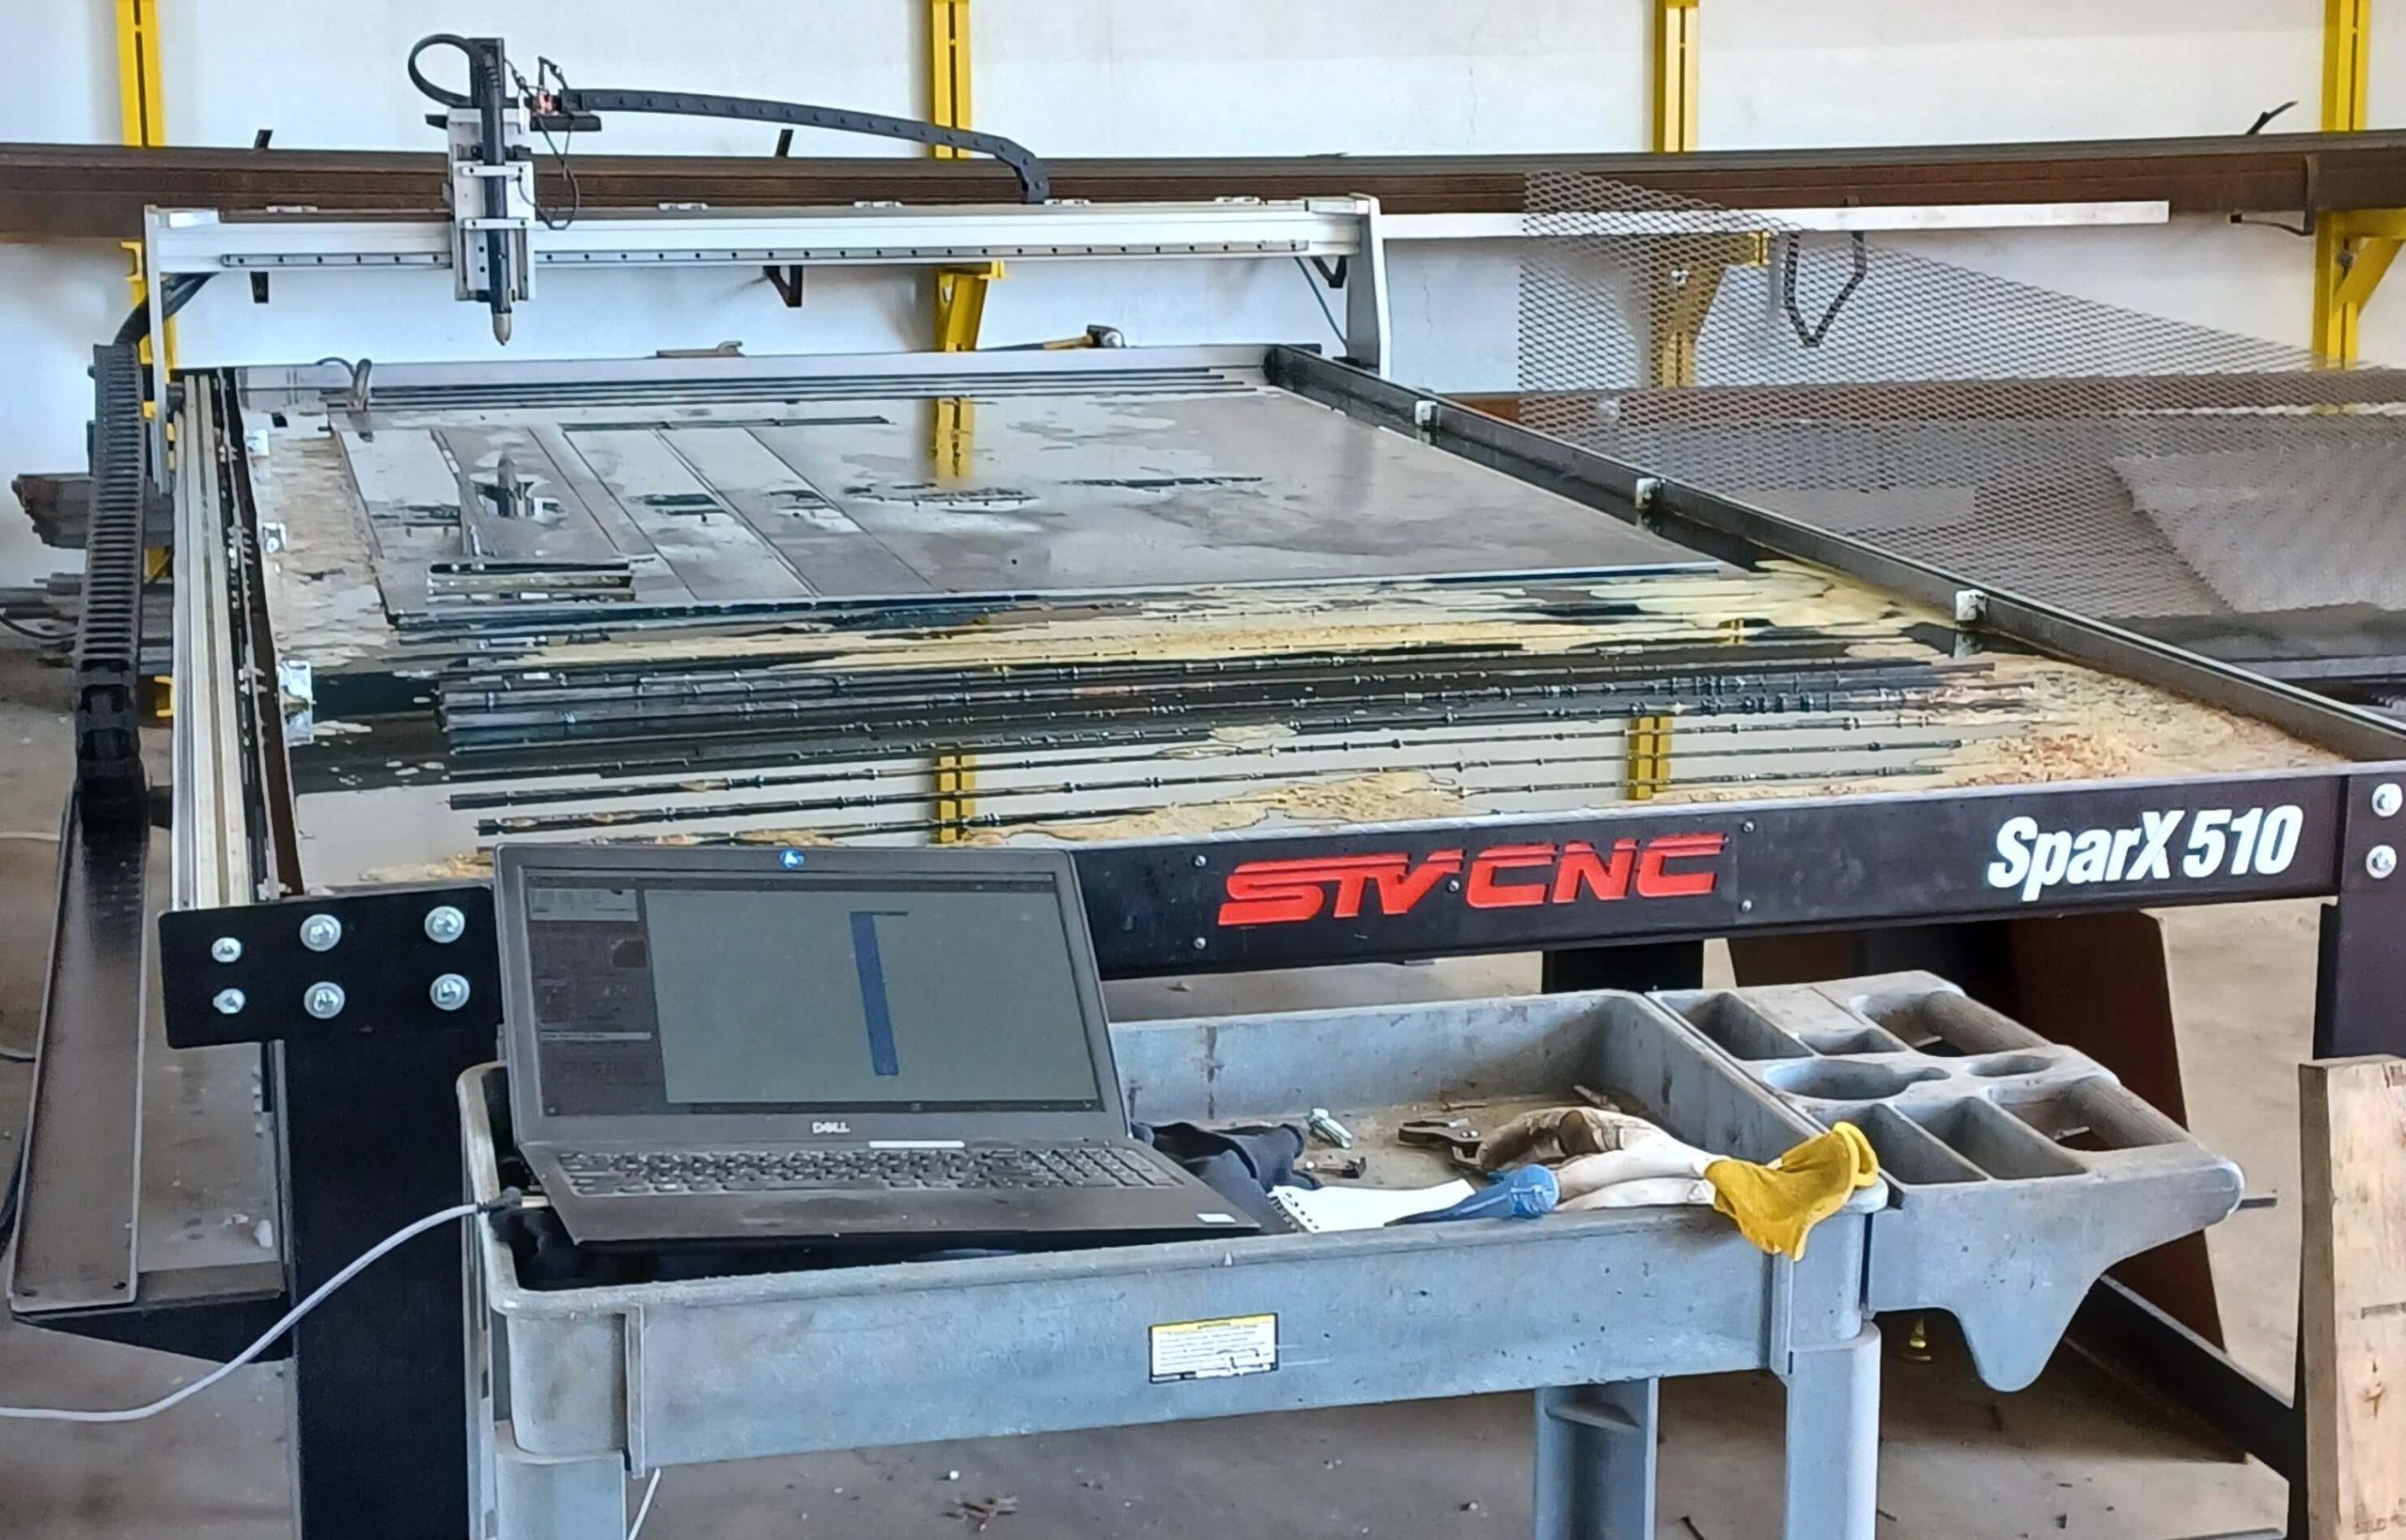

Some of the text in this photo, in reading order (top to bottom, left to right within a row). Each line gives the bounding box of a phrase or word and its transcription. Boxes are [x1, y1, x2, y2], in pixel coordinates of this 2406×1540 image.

[1987, 804, 2304, 902] SparX 510
[812, 1121, 851, 1134] DELL
